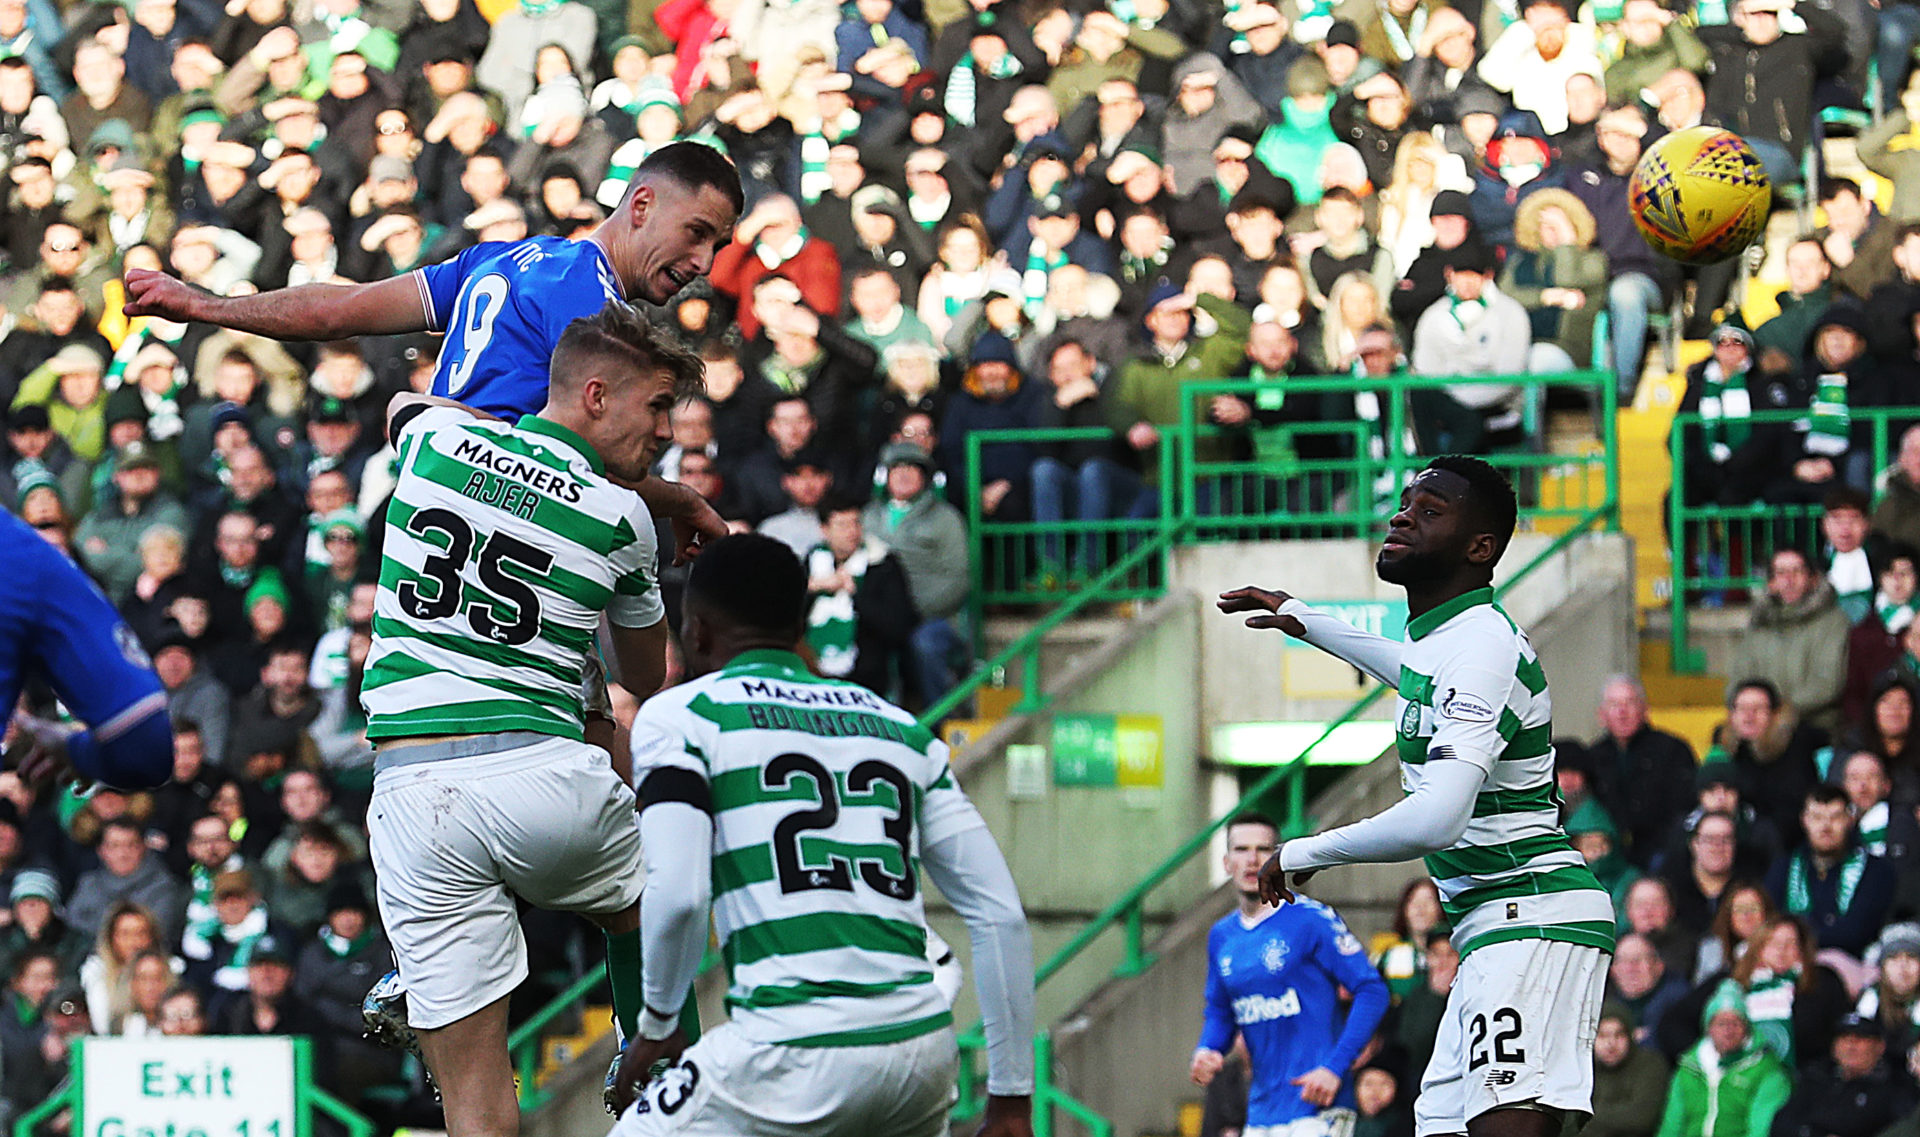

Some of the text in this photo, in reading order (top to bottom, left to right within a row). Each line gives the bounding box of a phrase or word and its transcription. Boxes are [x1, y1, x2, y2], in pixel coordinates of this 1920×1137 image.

[453, 439, 584, 503] MAGNERS
[461, 470, 540, 521] AJER
[396, 505, 557, 648] 35
[1313, 604, 1390, 636] IT
[741, 681, 882, 710] MAGNERS
[761, 751, 918, 902] 23
[1468, 1006, 1526, 1074] 22
[141, 1061, 232, 1097] Exit
[656, 1060, 699, 1115] 3
